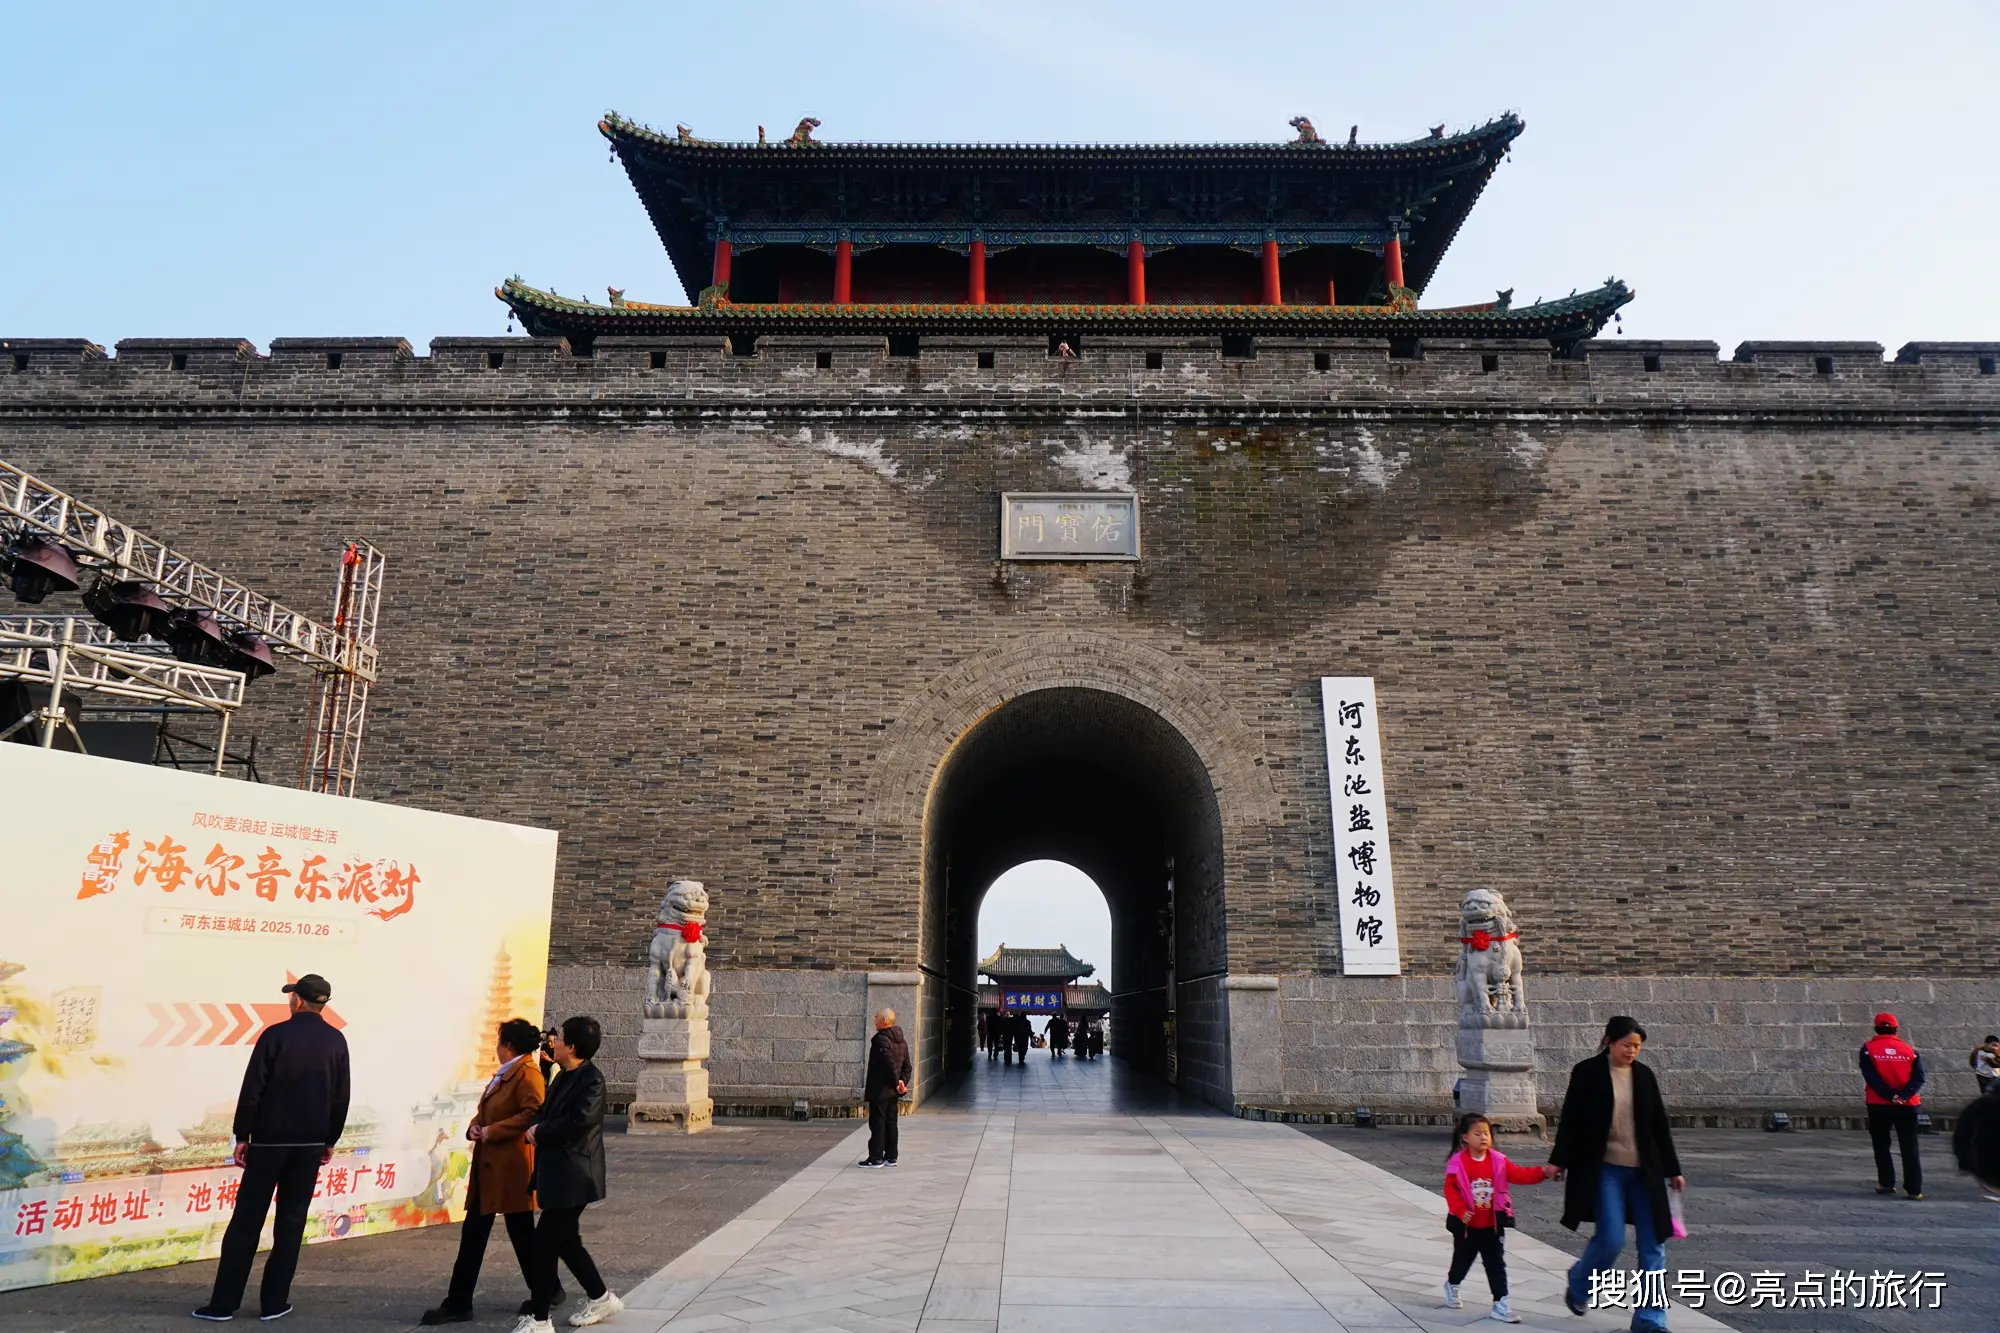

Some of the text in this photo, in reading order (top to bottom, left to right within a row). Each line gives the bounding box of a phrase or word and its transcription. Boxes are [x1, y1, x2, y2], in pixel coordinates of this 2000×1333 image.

[192, 812, 338, 844] 风吹麦浪起 运城慢生活
[1338, 700, 1384, 948] 河东池盐博物馆
[133, 834, 421, 921] 海尔音乐派对
[180, 914, 330, 936] 河东运城站 2025.10.26
